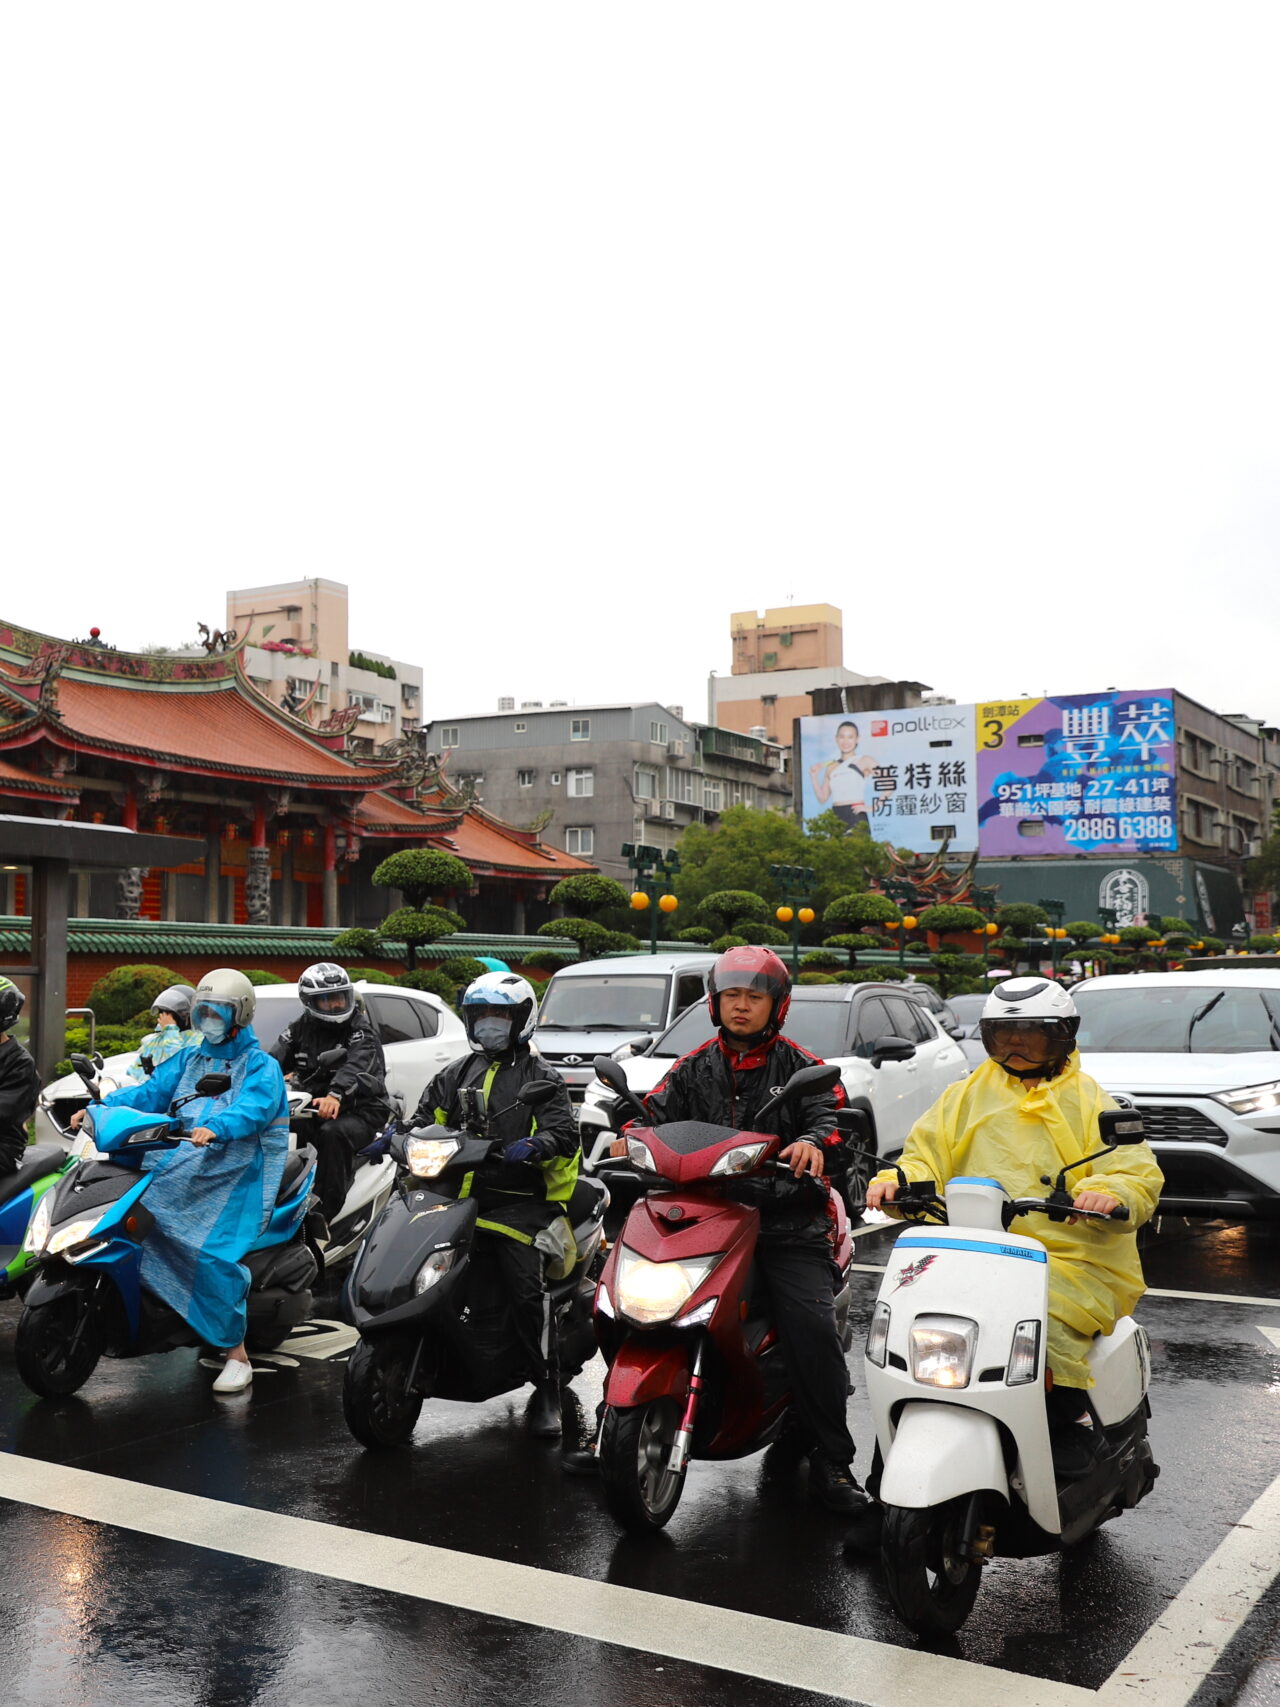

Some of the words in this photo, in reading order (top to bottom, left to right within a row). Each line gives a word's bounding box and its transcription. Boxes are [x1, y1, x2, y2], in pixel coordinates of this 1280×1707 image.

[983, 719, 1004, 748] 3
[1062, 702, 1170, 764] 豐萃
[871, 760, 967, 792] 普特絲
[997, 781, 1082, 801] 951坪基地
[1087, 777, 1169, 797] 27-41坪
[1064, 817, 1116, 842] 2886
[1119, 815, 1172, 839] 6388
[1000, 1246, 1034, 1259] YAMAHA
